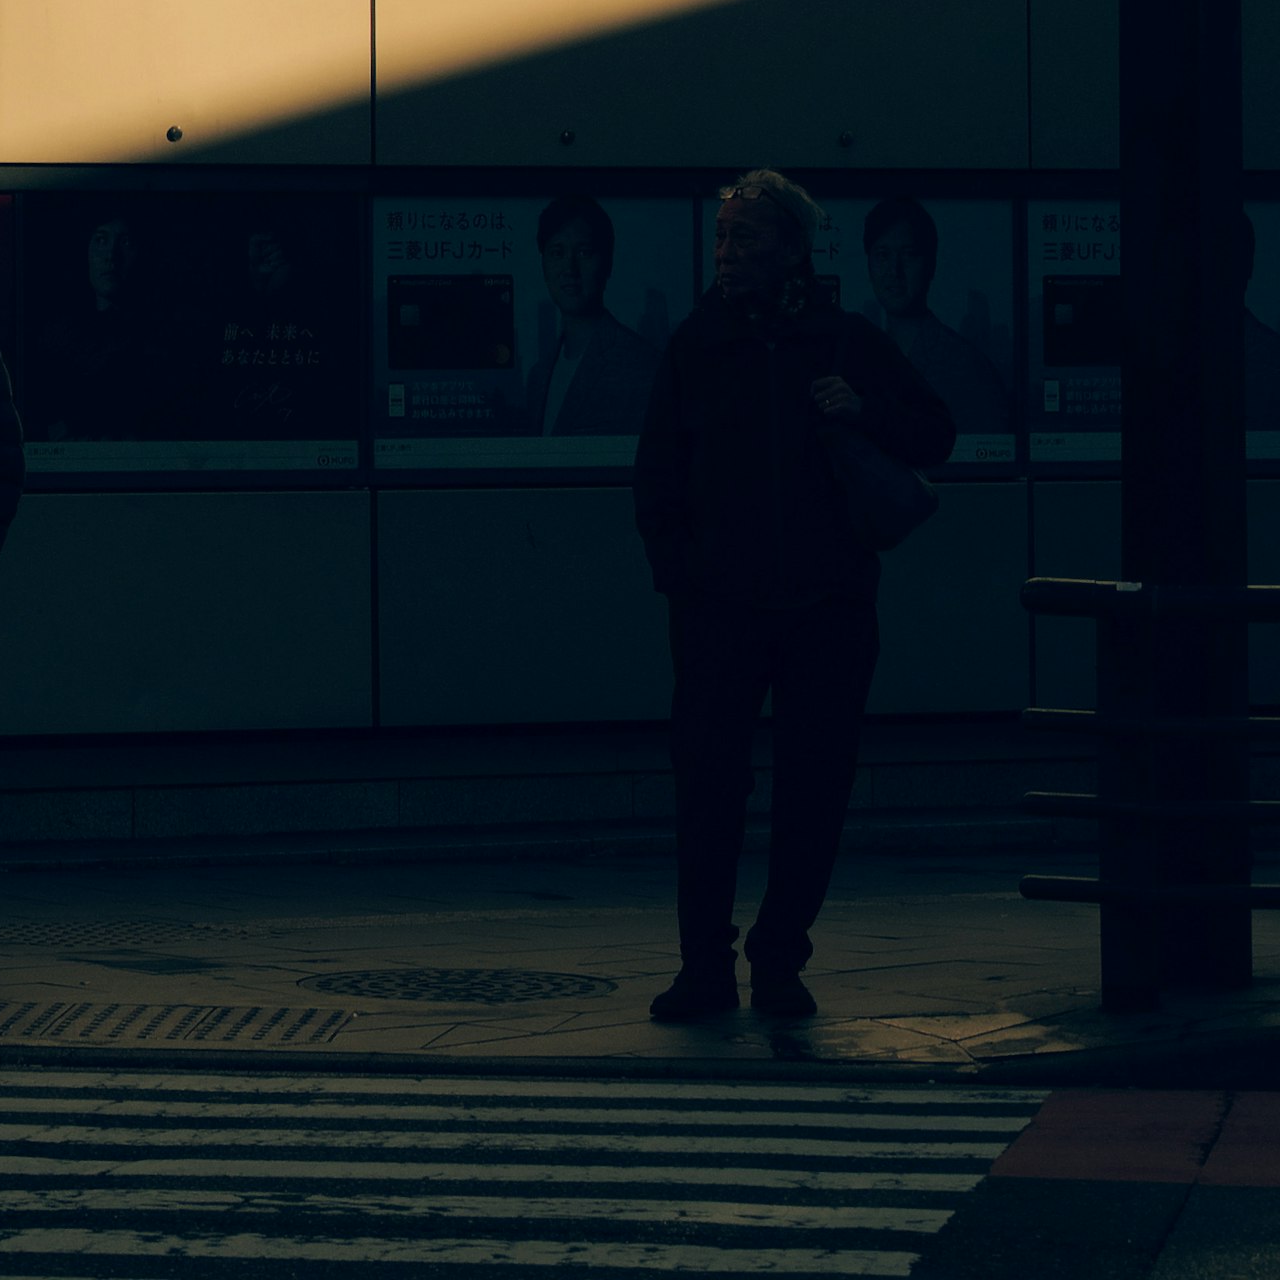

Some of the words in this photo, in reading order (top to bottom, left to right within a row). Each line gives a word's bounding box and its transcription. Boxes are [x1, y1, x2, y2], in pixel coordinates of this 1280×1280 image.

[1041, 213, 1121, 232] 頼りになる
[386, 240, 513, 261] 三菱UFJカード
[1042, 241, 1121, 261] 三菱UFJ
